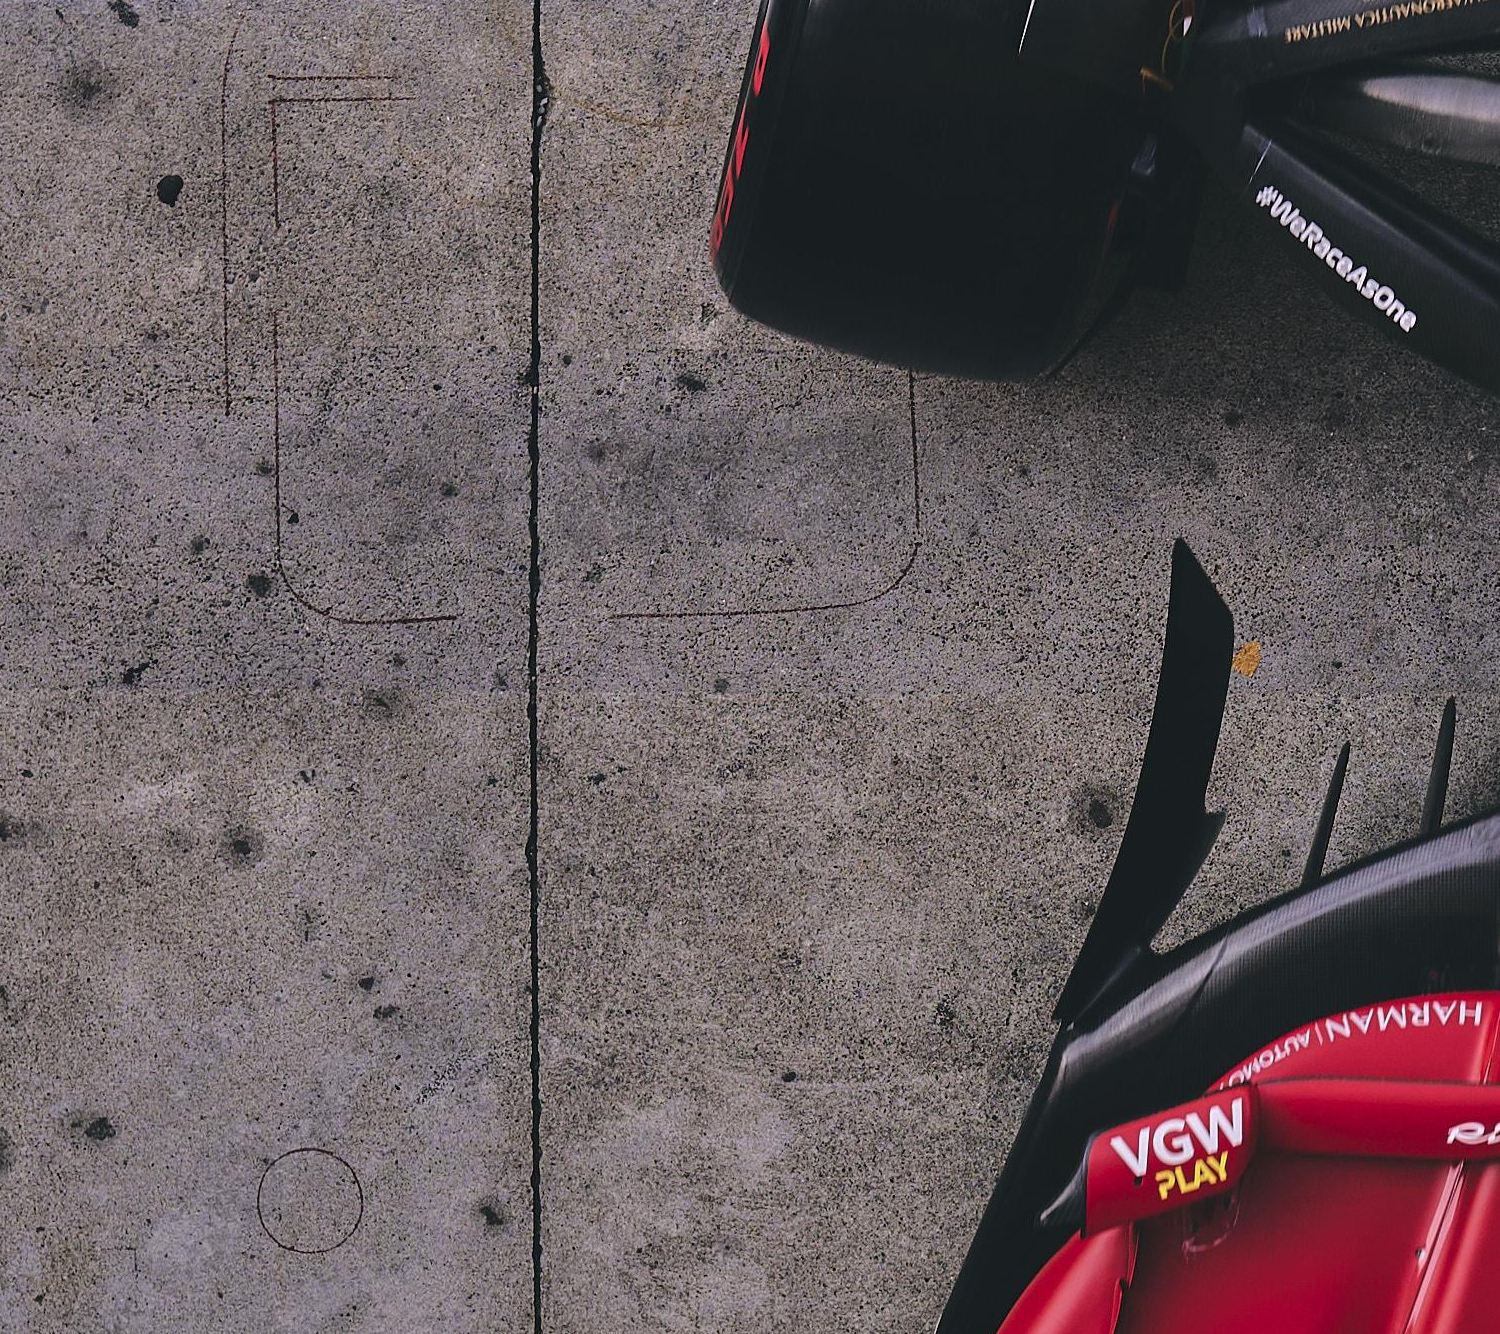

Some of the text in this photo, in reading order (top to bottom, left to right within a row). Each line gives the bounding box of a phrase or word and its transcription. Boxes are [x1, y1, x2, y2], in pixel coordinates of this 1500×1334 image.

[1284, 15, 1351, 44] MILITARE
[1255, 185, 1418, 334] #WeRaceAsOne
[1327, 1000, 1483, 1043] HARMAN
[1109, 1096, 1244, 1178] VGW
[1155, 1150, 1230, 1201] PLAY
